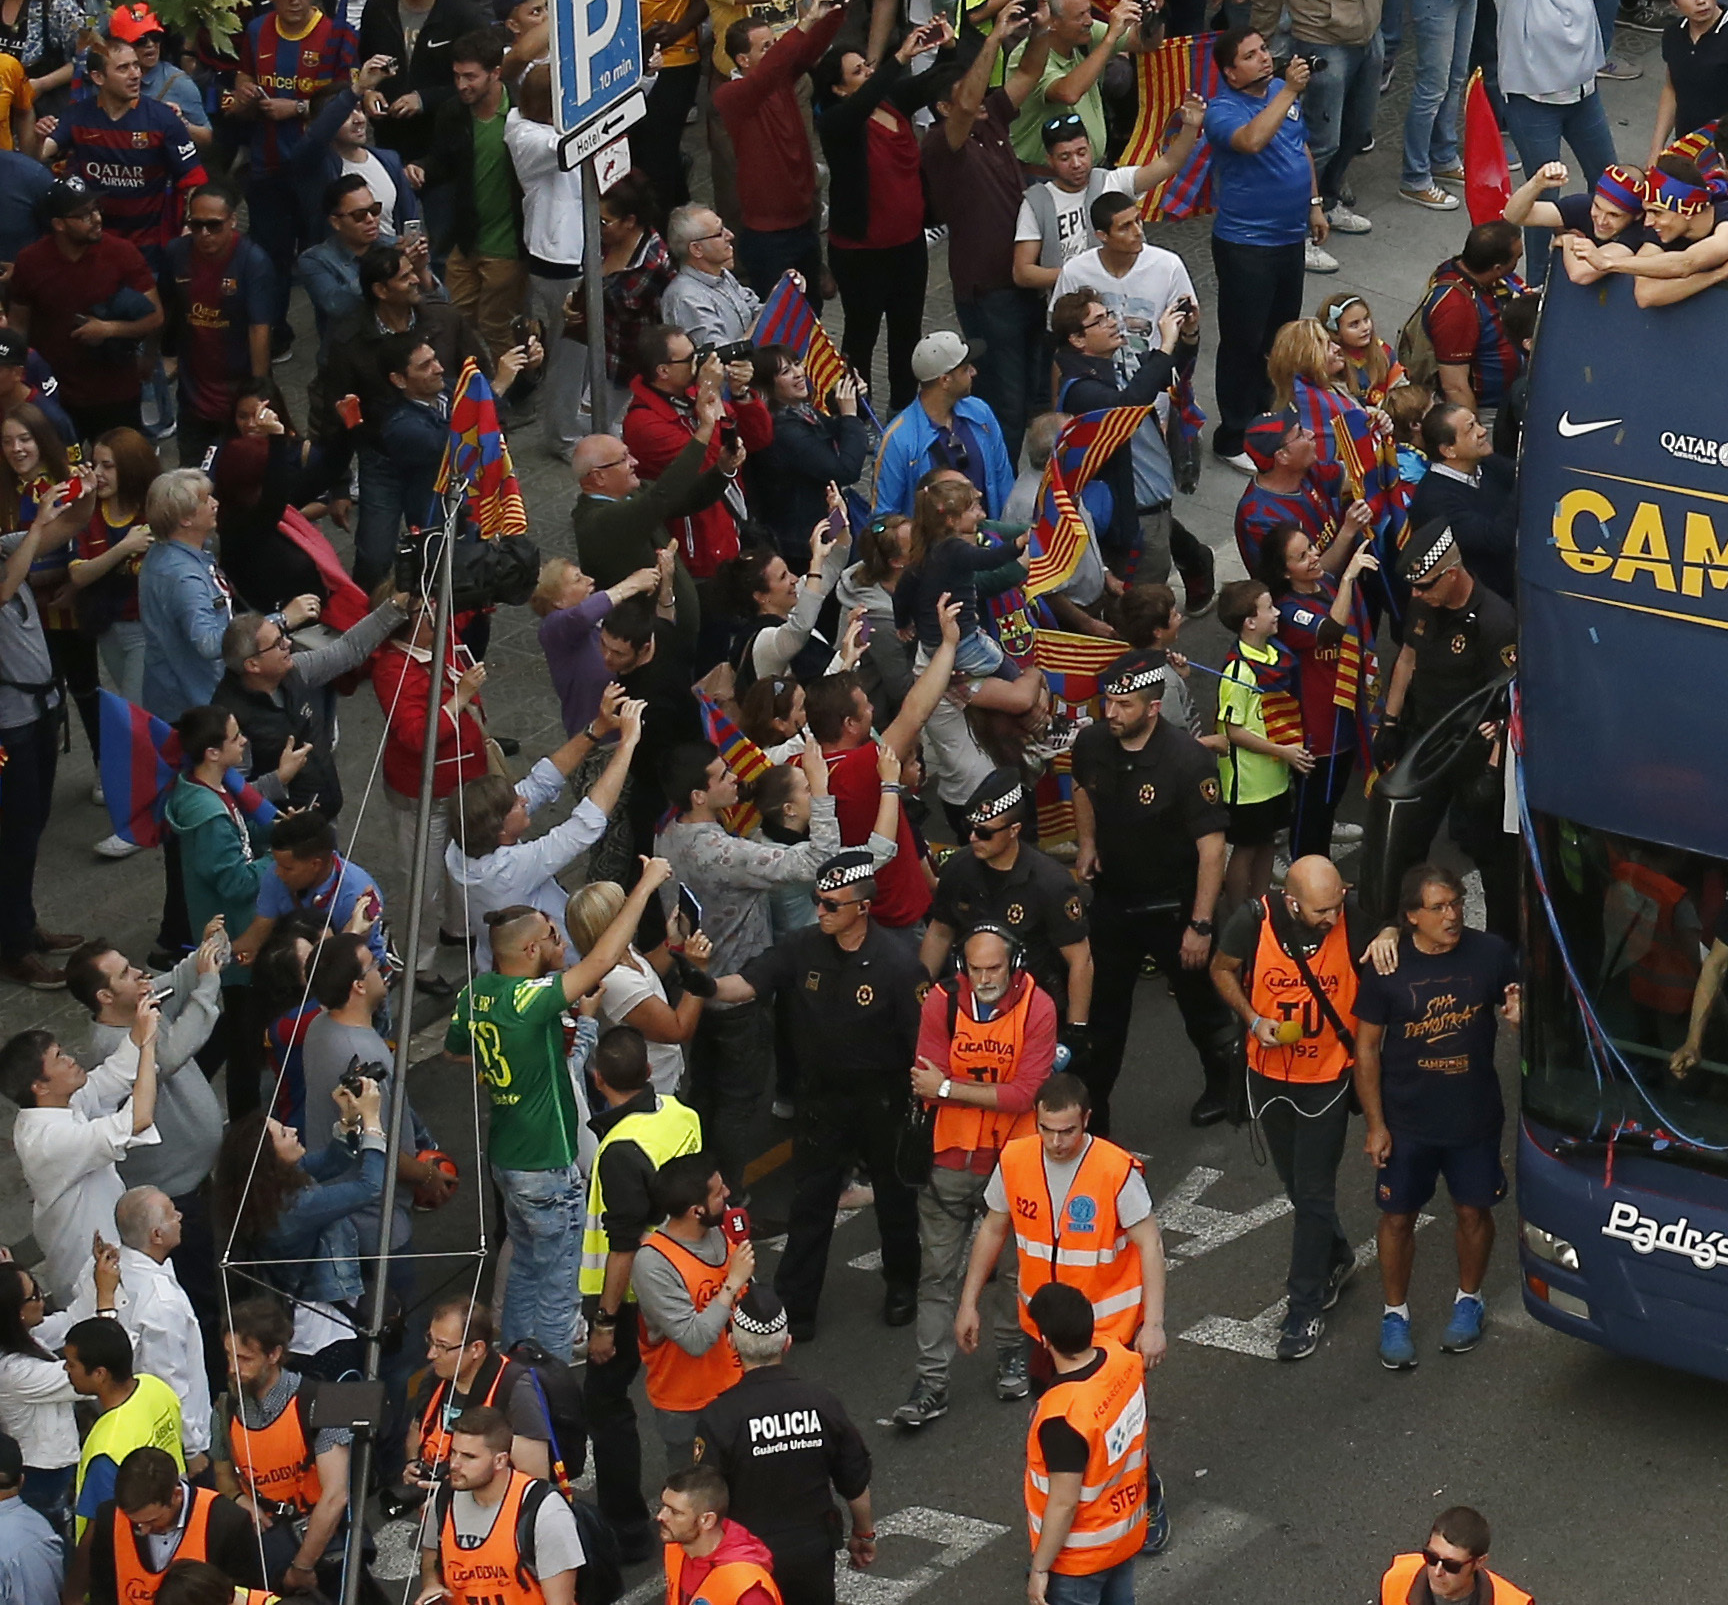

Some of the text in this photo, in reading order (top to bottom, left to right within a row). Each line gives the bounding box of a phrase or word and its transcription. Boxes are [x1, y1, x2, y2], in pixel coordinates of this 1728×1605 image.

[257, 71, 298, 89] unicef
[599, 69, 614, 91] 10
[576, 127, 601, 155] Hotel
[86, 161, 144, 179] QATAR
[100, 177, 145, 188] AIRWAYS
[1660, 431, 1718, 458] QATAR
[1016, 1196, 1038, 1220] 522
[749, 1409, 822, 1442] POLICIA
[789, 1437, 823, 1451] Urbana
